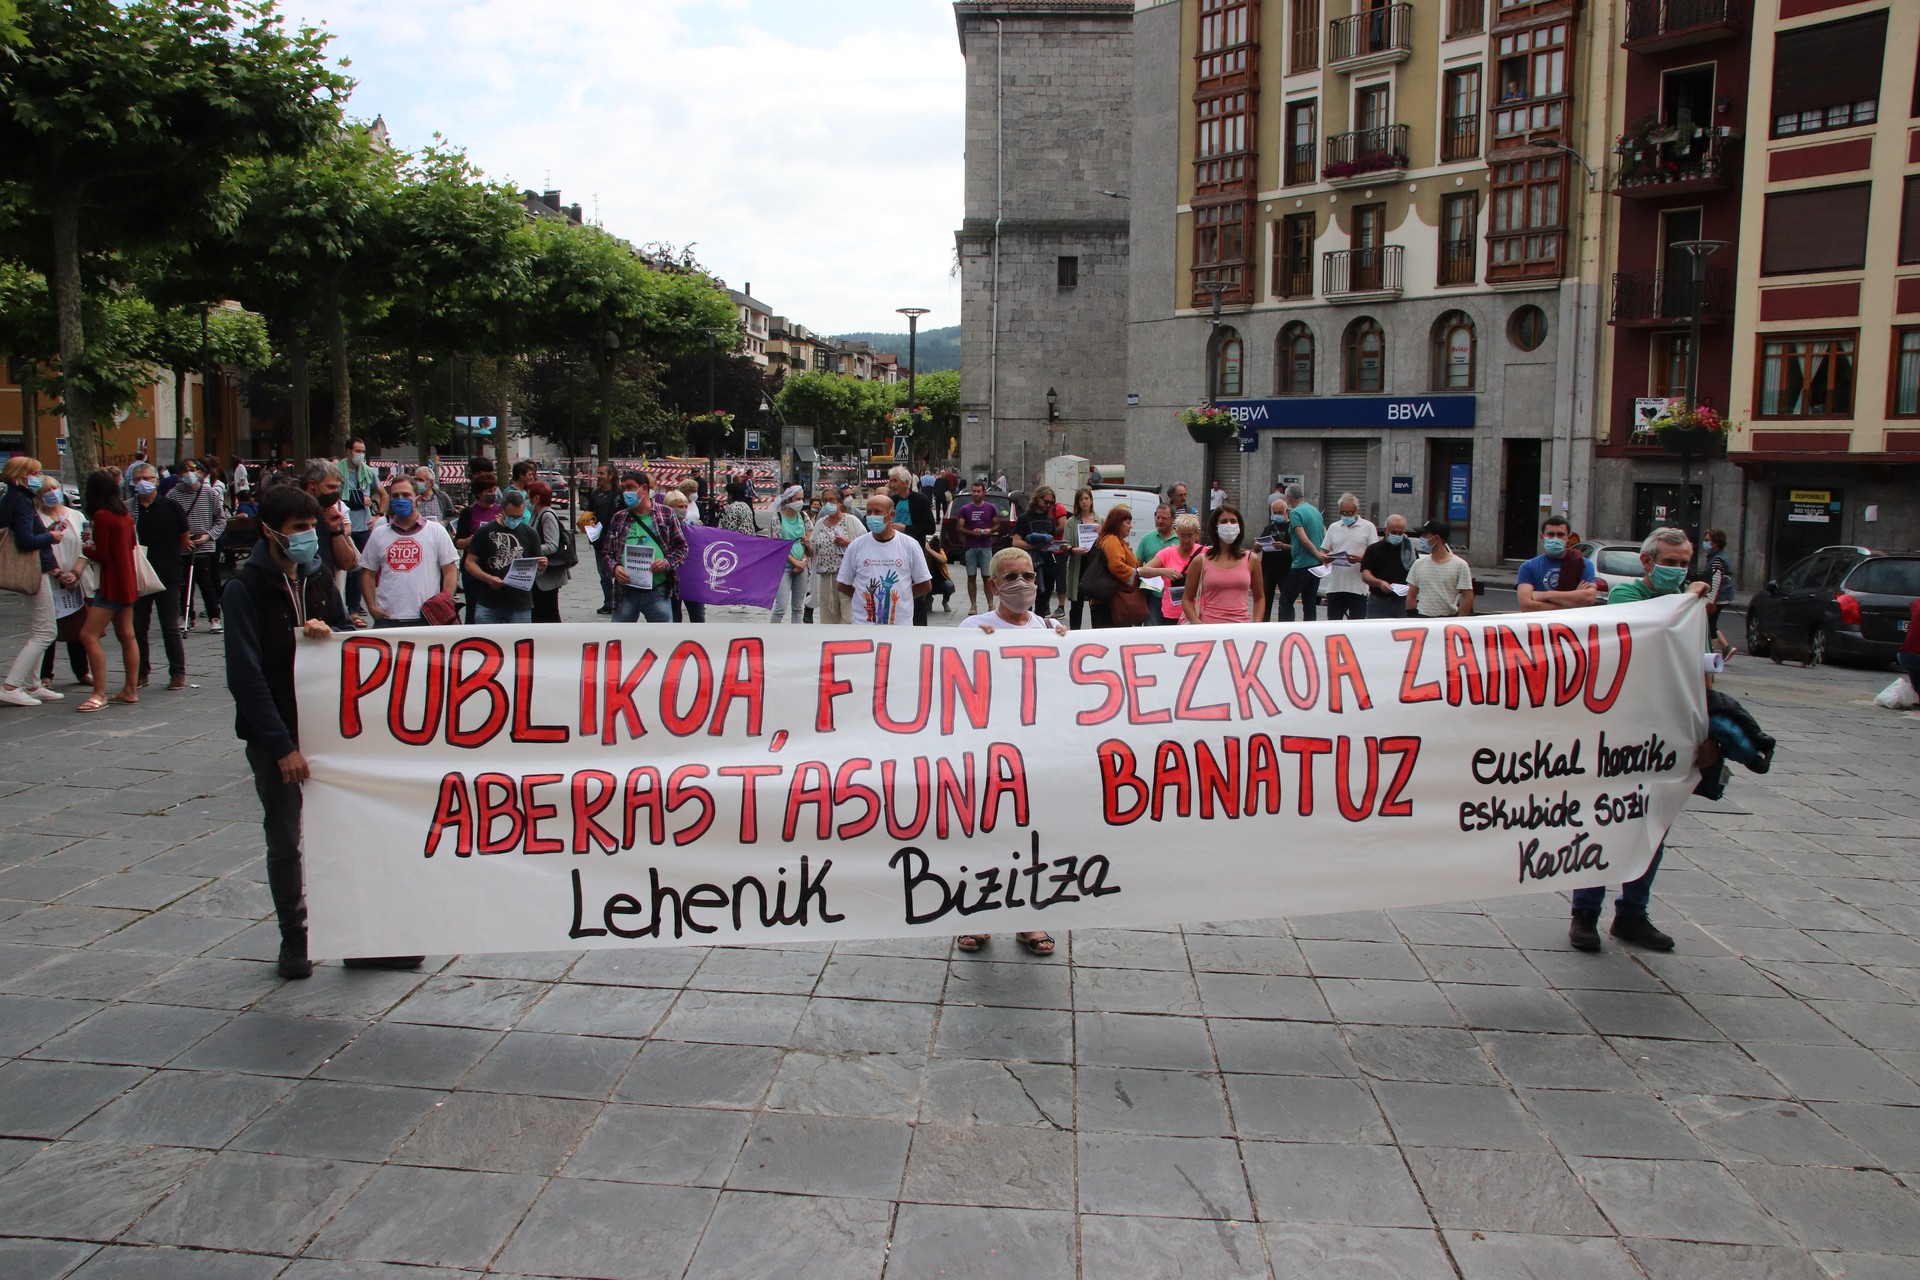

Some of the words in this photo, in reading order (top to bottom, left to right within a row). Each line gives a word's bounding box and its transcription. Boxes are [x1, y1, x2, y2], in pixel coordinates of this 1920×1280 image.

[1230, 405, 1269, 421] BBVA
[1388, 402, 1435, 420] BBVA
[390, 547, 419, 558] STOP
[340, 637, 788, 753] PUBLIKOA,
[816, 632, 1373, 736] FUNTSEZKOA
[1392, 622, 1632, 714] ZAINDU
[424, 741, 1029, 859] ABERASTASUNA
[1098, 733, 1421, 827] BANATUZ
[1460, 789, 1584, 832] eskubide
[1518, 832, 1609, 884] Karta
[568, 855, 845, 939] Lehenik
[888, 831, 1121, 926] Bizitza
